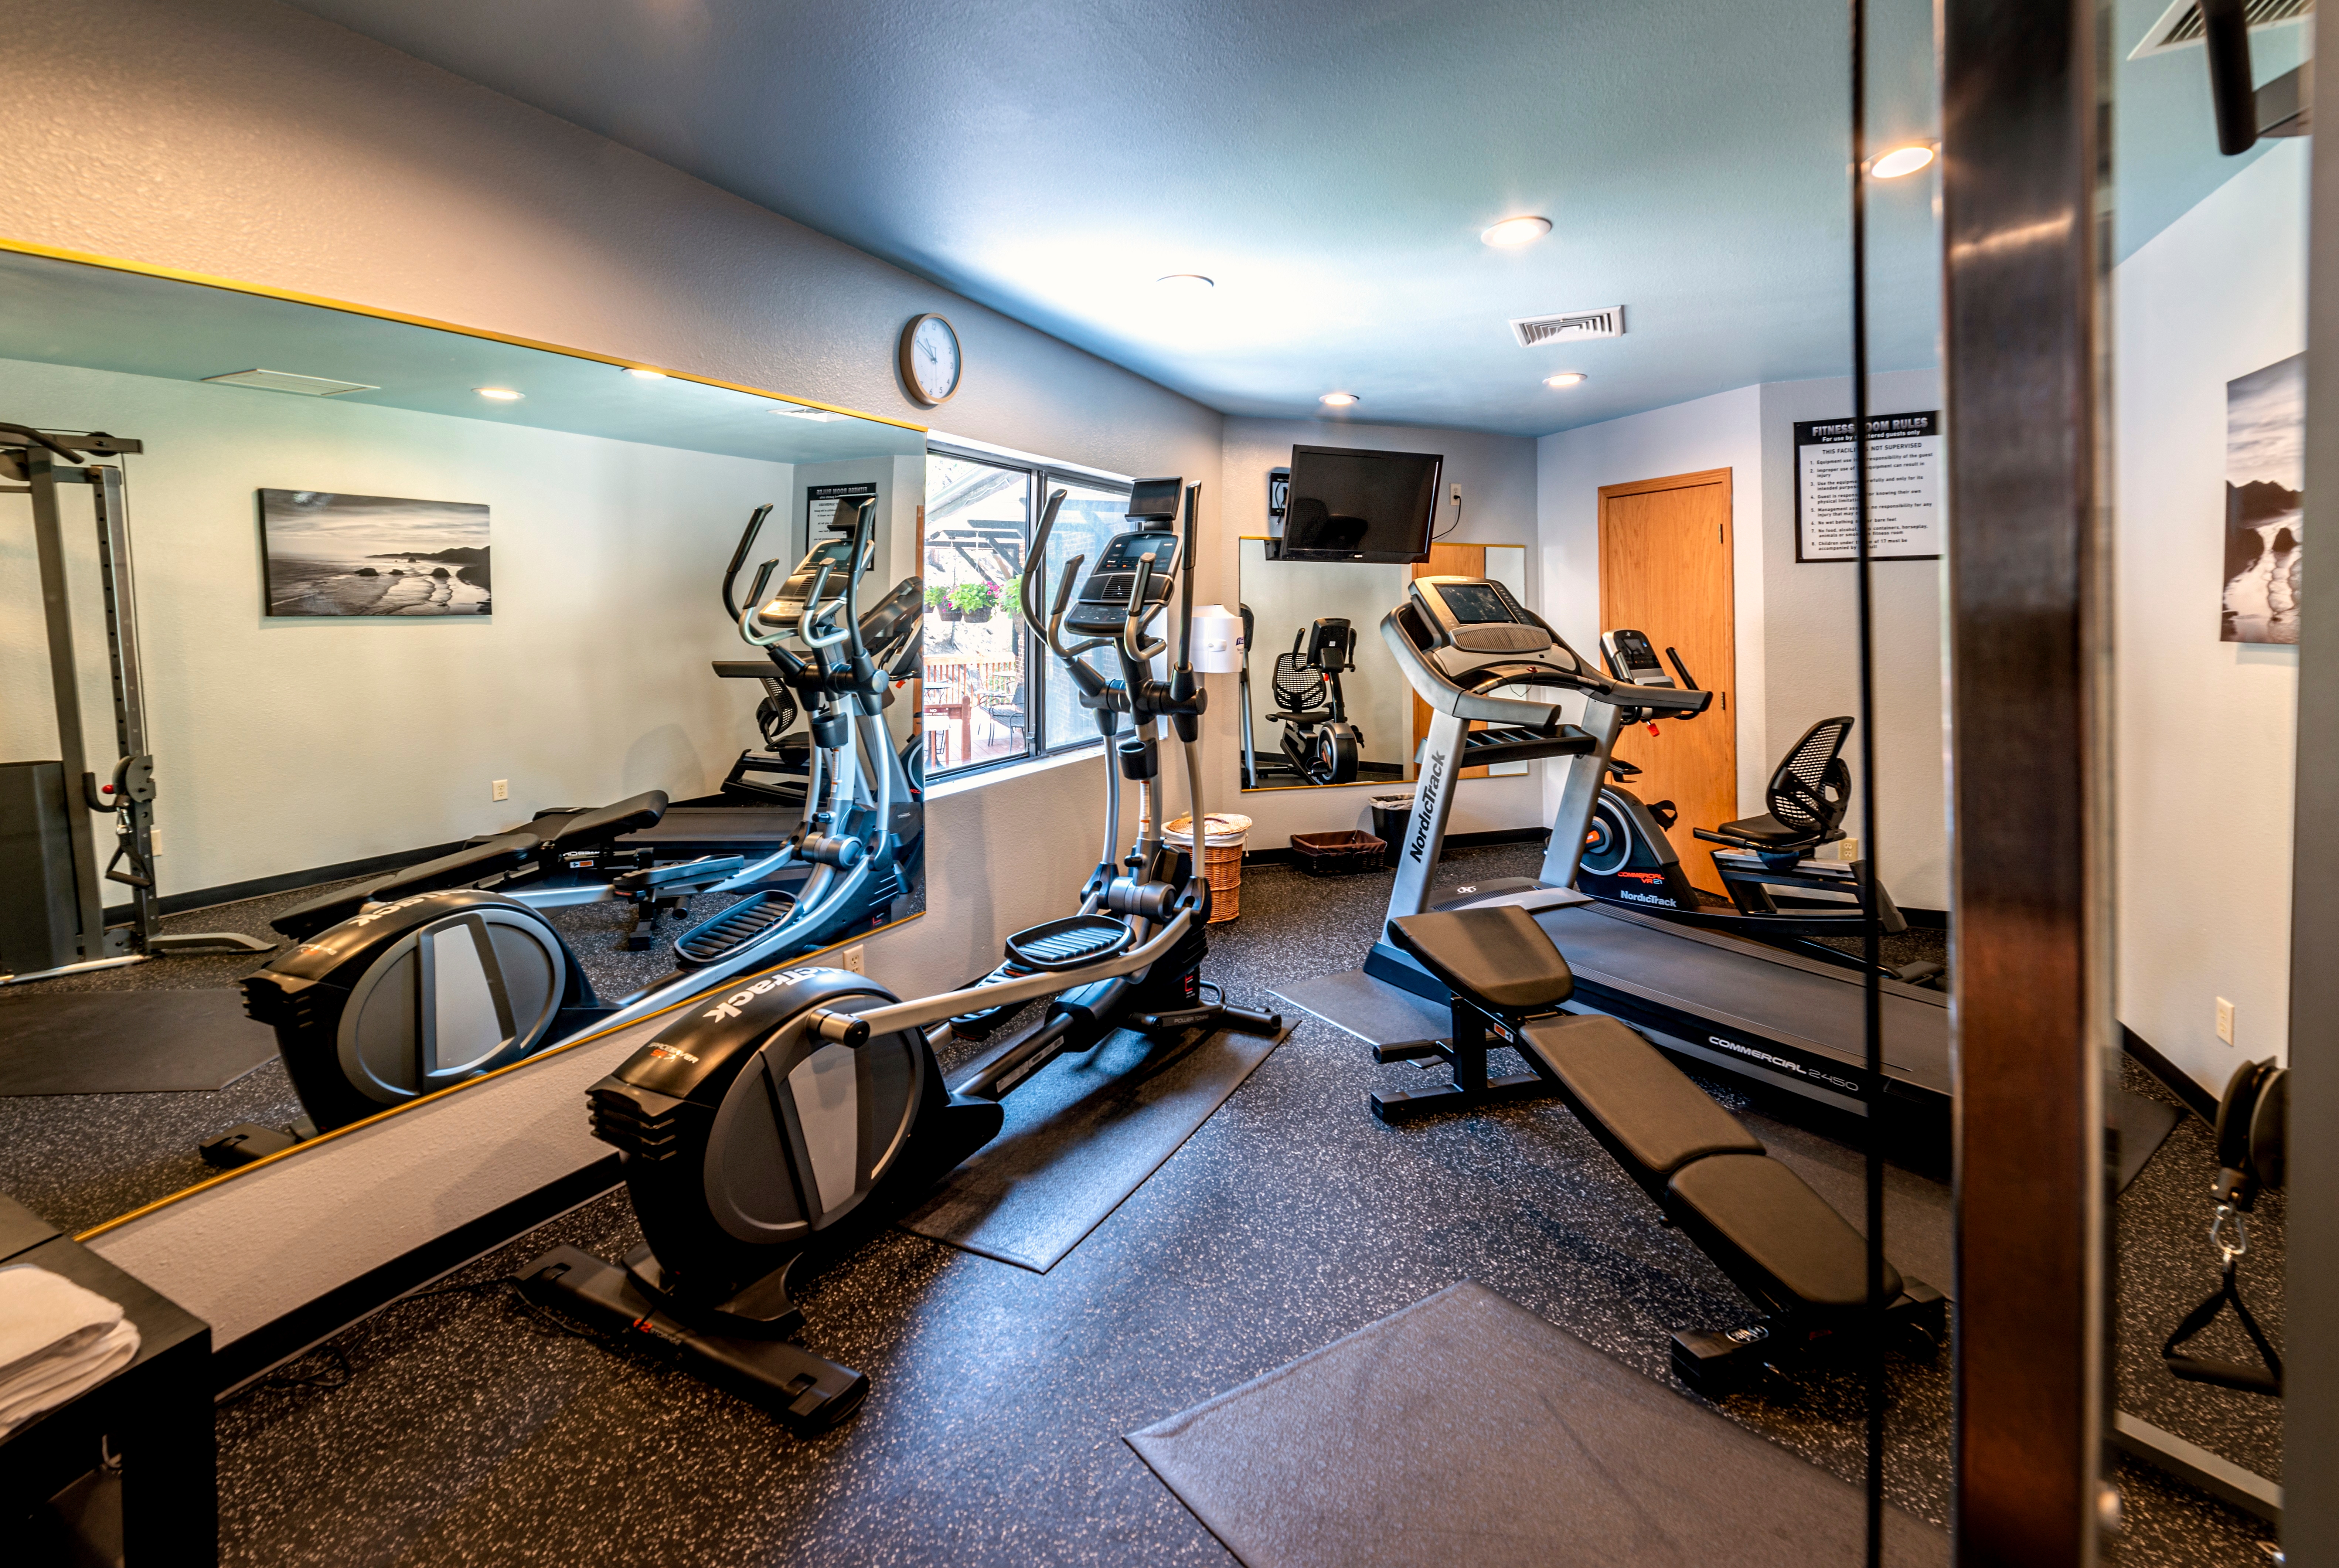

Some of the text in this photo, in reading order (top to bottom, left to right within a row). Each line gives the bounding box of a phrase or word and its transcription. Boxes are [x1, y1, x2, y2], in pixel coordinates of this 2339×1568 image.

[1812, 417, 1928, 436] FITNESS OOM RULES
[1410, 750, 1445, 864] NordicTrack
[1618, 871, 1665, 880] COMMERCIAL
[1621, 890, 1677, 907] NordicTrack
[1708, 1035, 1859, 1092] COMMERCIAL 2450
